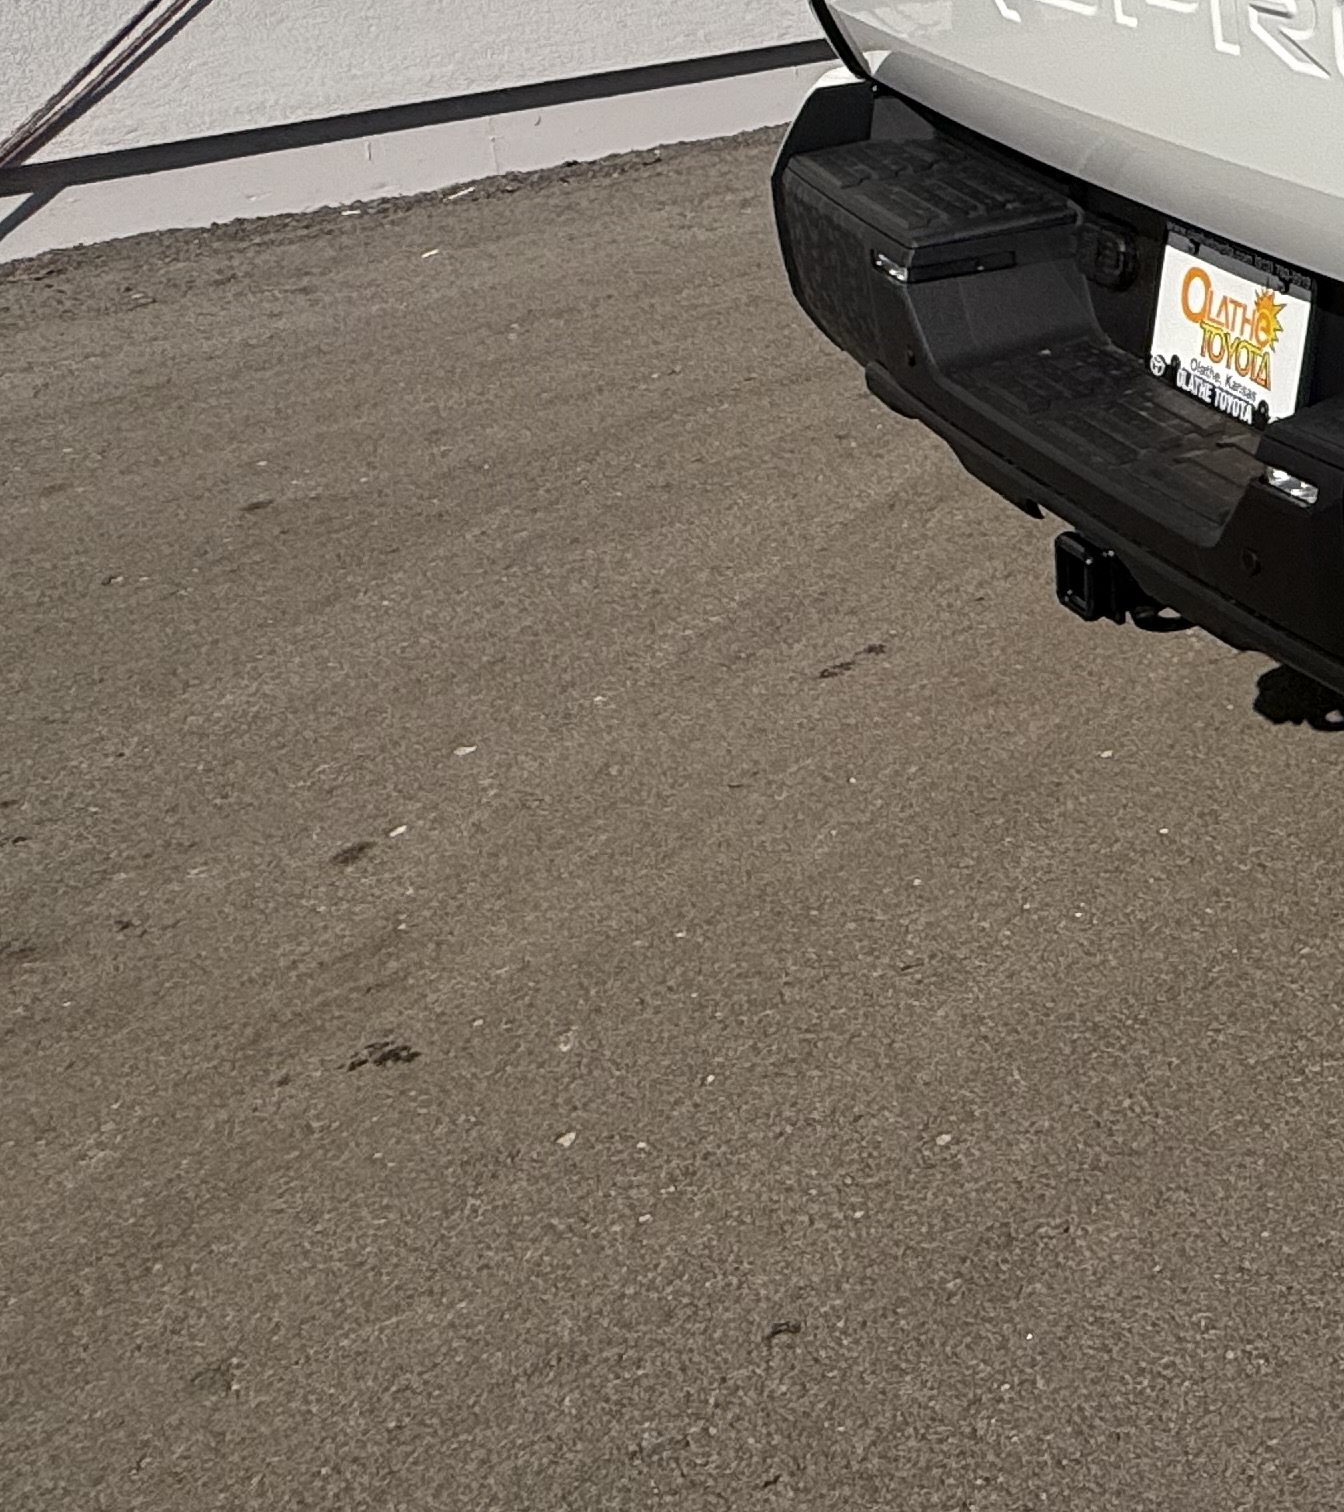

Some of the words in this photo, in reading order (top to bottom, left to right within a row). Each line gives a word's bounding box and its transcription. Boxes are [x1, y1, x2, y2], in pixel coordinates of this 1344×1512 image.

[1200, 319, 1272, 392] TOYOTA
[1176, 366, 1213, 404] OLATHE
[1214, 387, 1253, 425] TOYOTA
